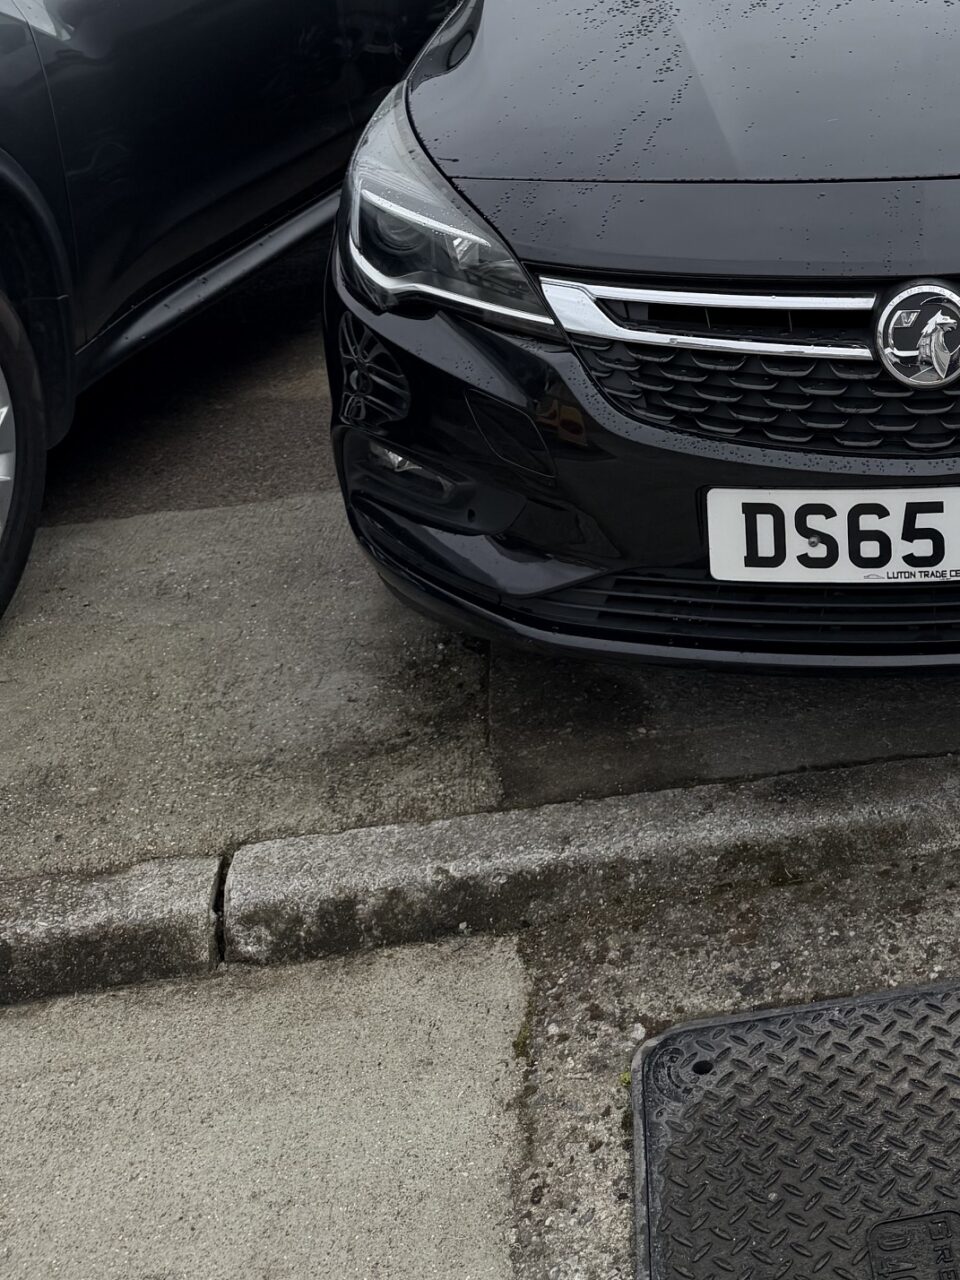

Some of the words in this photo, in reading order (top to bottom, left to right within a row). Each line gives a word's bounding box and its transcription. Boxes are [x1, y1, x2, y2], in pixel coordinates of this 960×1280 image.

[741, 500, 946, 569] DS65
[886, 571, 916, 580] LUTON
[918, 570, 948, 579] TRADE
